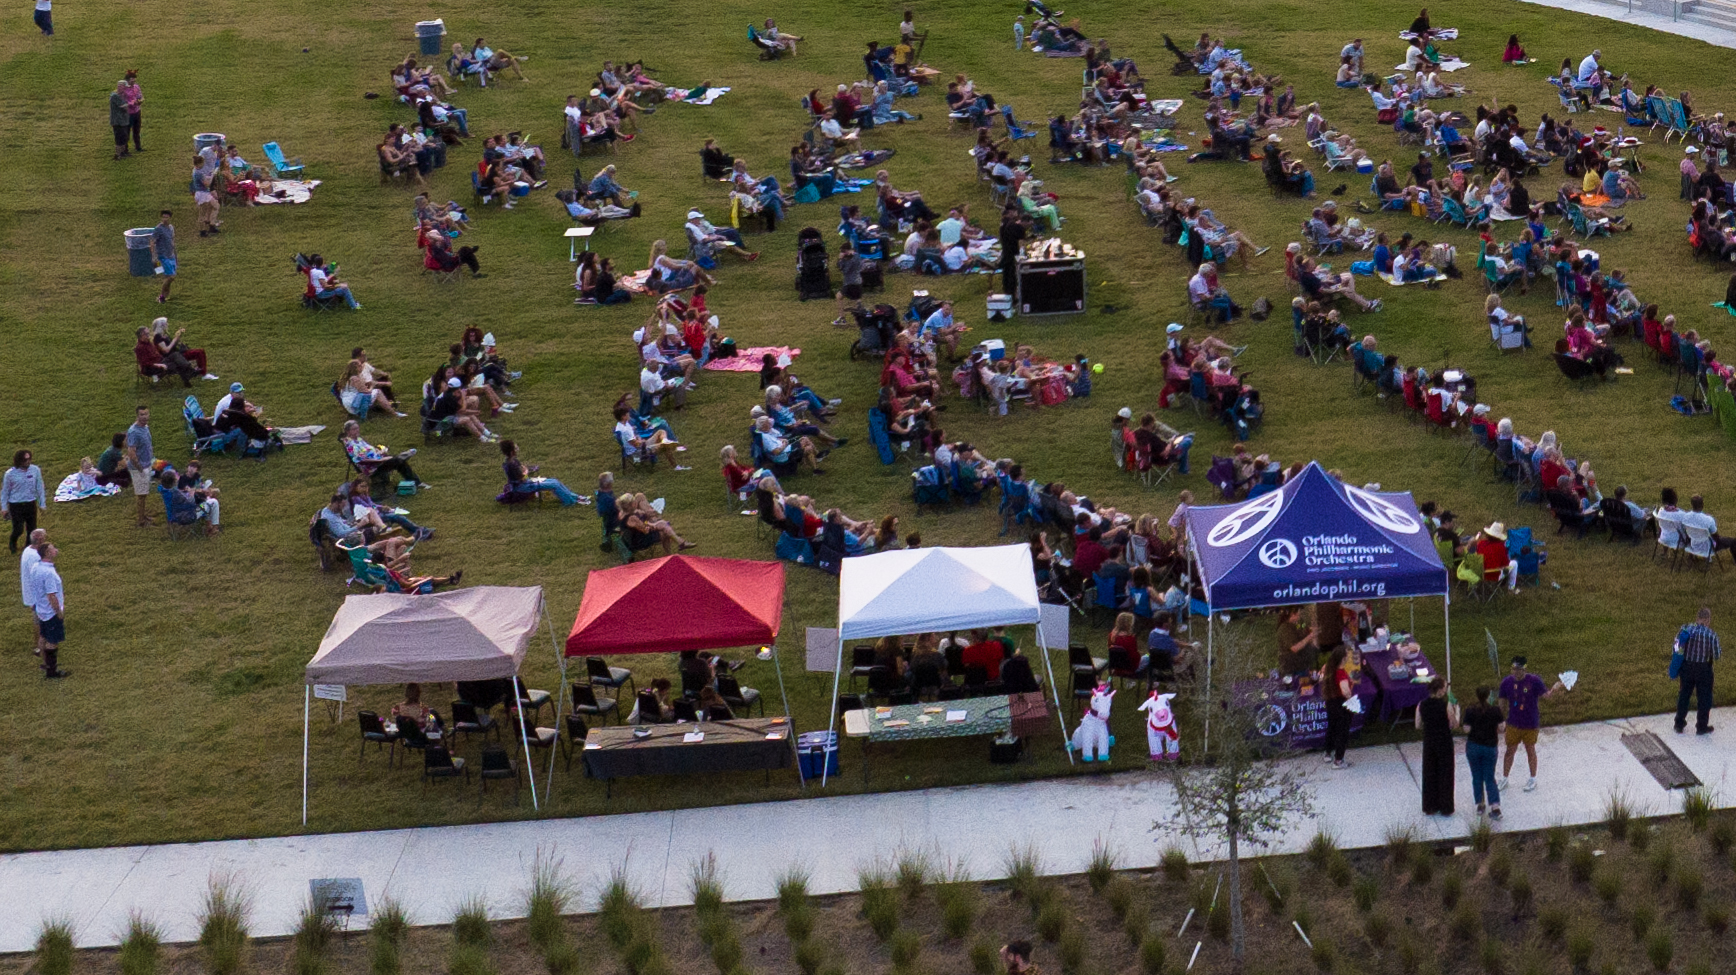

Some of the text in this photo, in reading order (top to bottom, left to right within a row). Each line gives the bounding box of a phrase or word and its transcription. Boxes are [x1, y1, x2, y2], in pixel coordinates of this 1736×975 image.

[1302, 533, 1357, 546] Orlando
[1304, 544, 1394, 556] Philharmonic
[1305, 555, 1374, 565] Orchestra
[1273, 579, 1385, 599] orlandophil.org
[1291, 700, 1326, 712] Orlan
